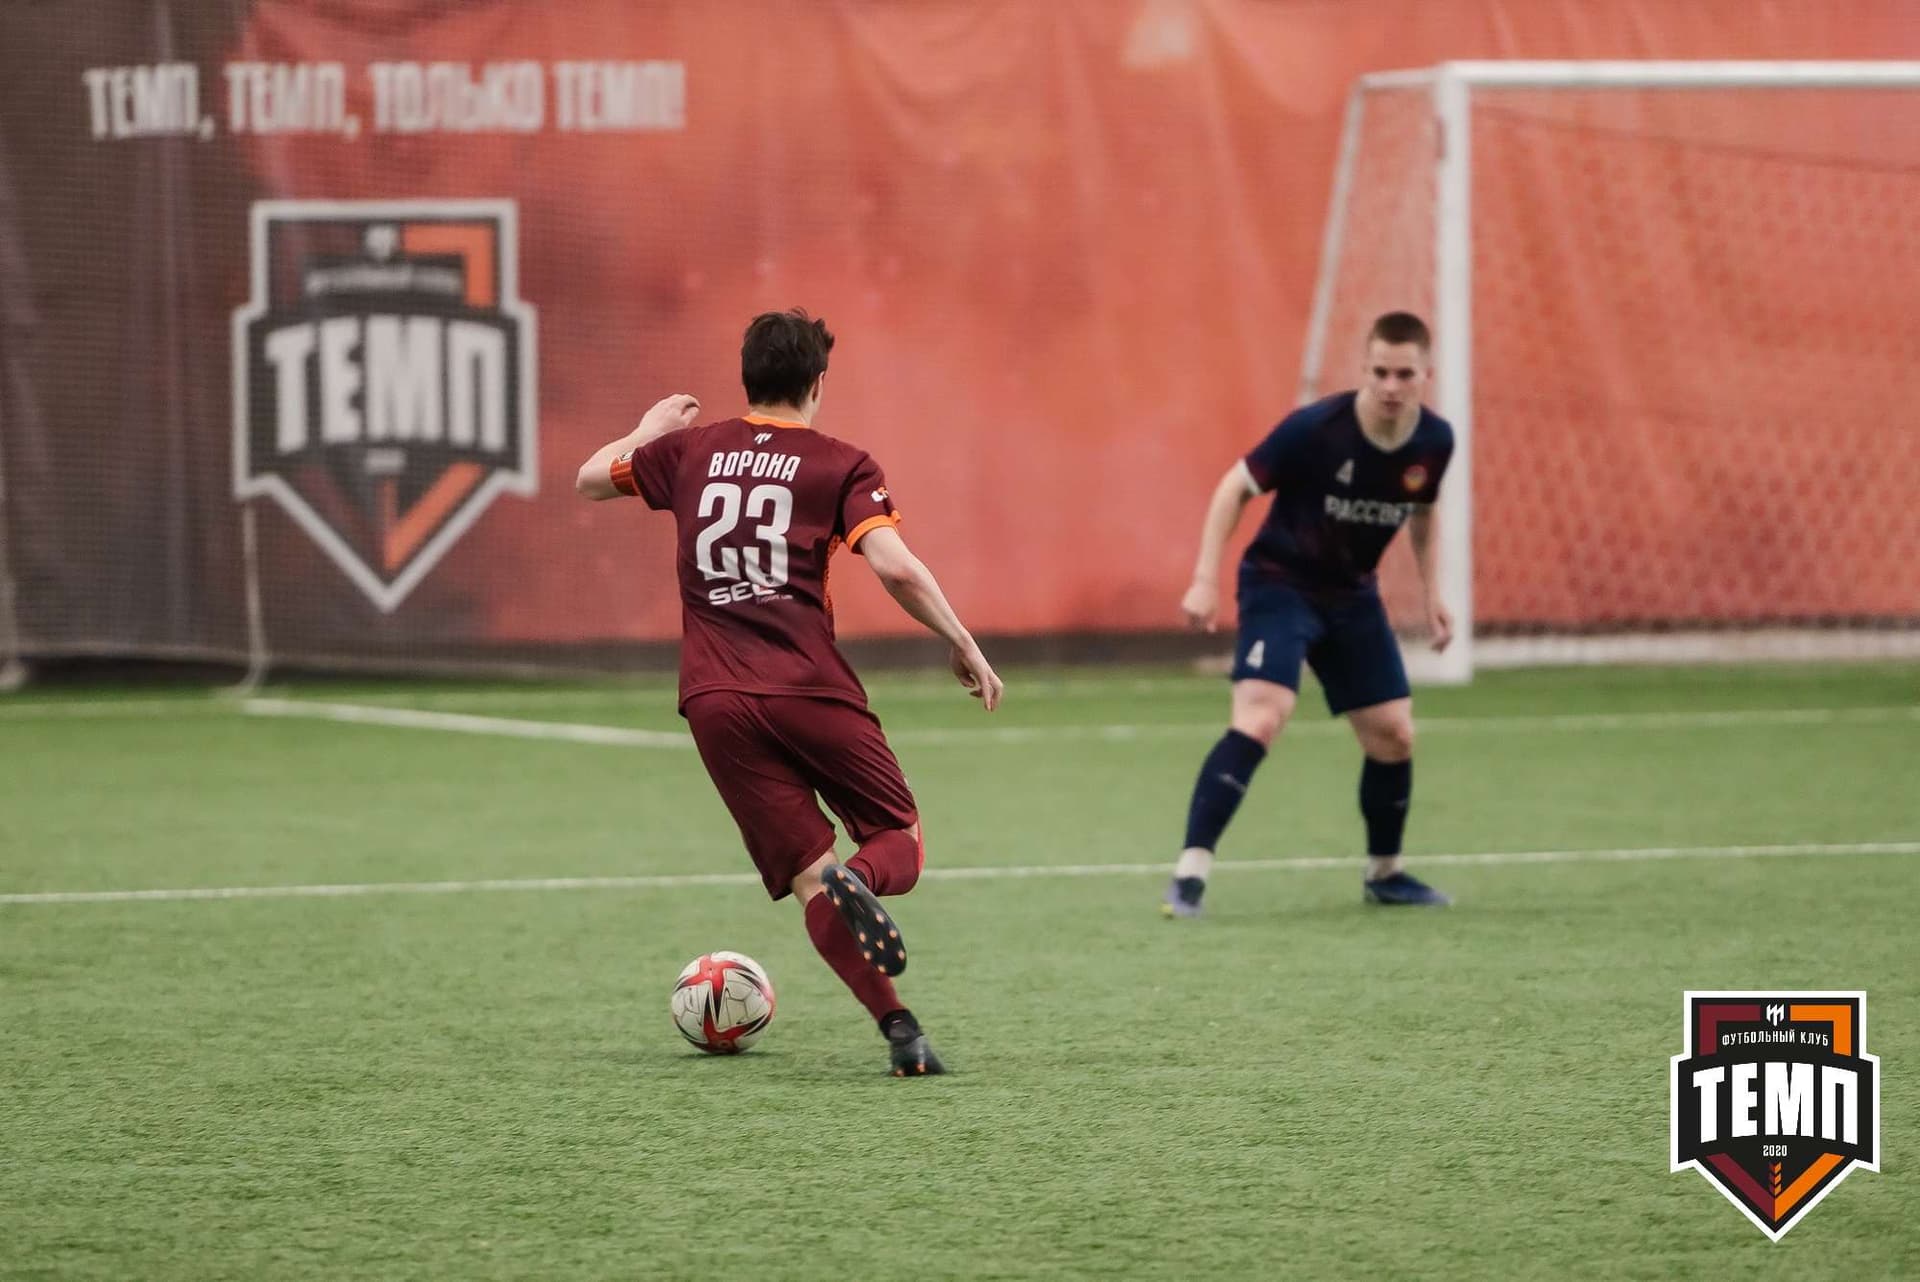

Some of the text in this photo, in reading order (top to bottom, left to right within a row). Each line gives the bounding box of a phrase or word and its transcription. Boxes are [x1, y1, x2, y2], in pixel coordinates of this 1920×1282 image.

[83, 62, 214, 140] ТЕМП,
[224, 61, 360, 139] ТЕМП,
[264, 313, 507, 454] ТЕМП
[708, 450, 801, 482] ВОРОНА
[1335, 458, 1354, 485] 4
[696, 482, 793, 587] 23
[1246, 640, 1265, 668] 4
